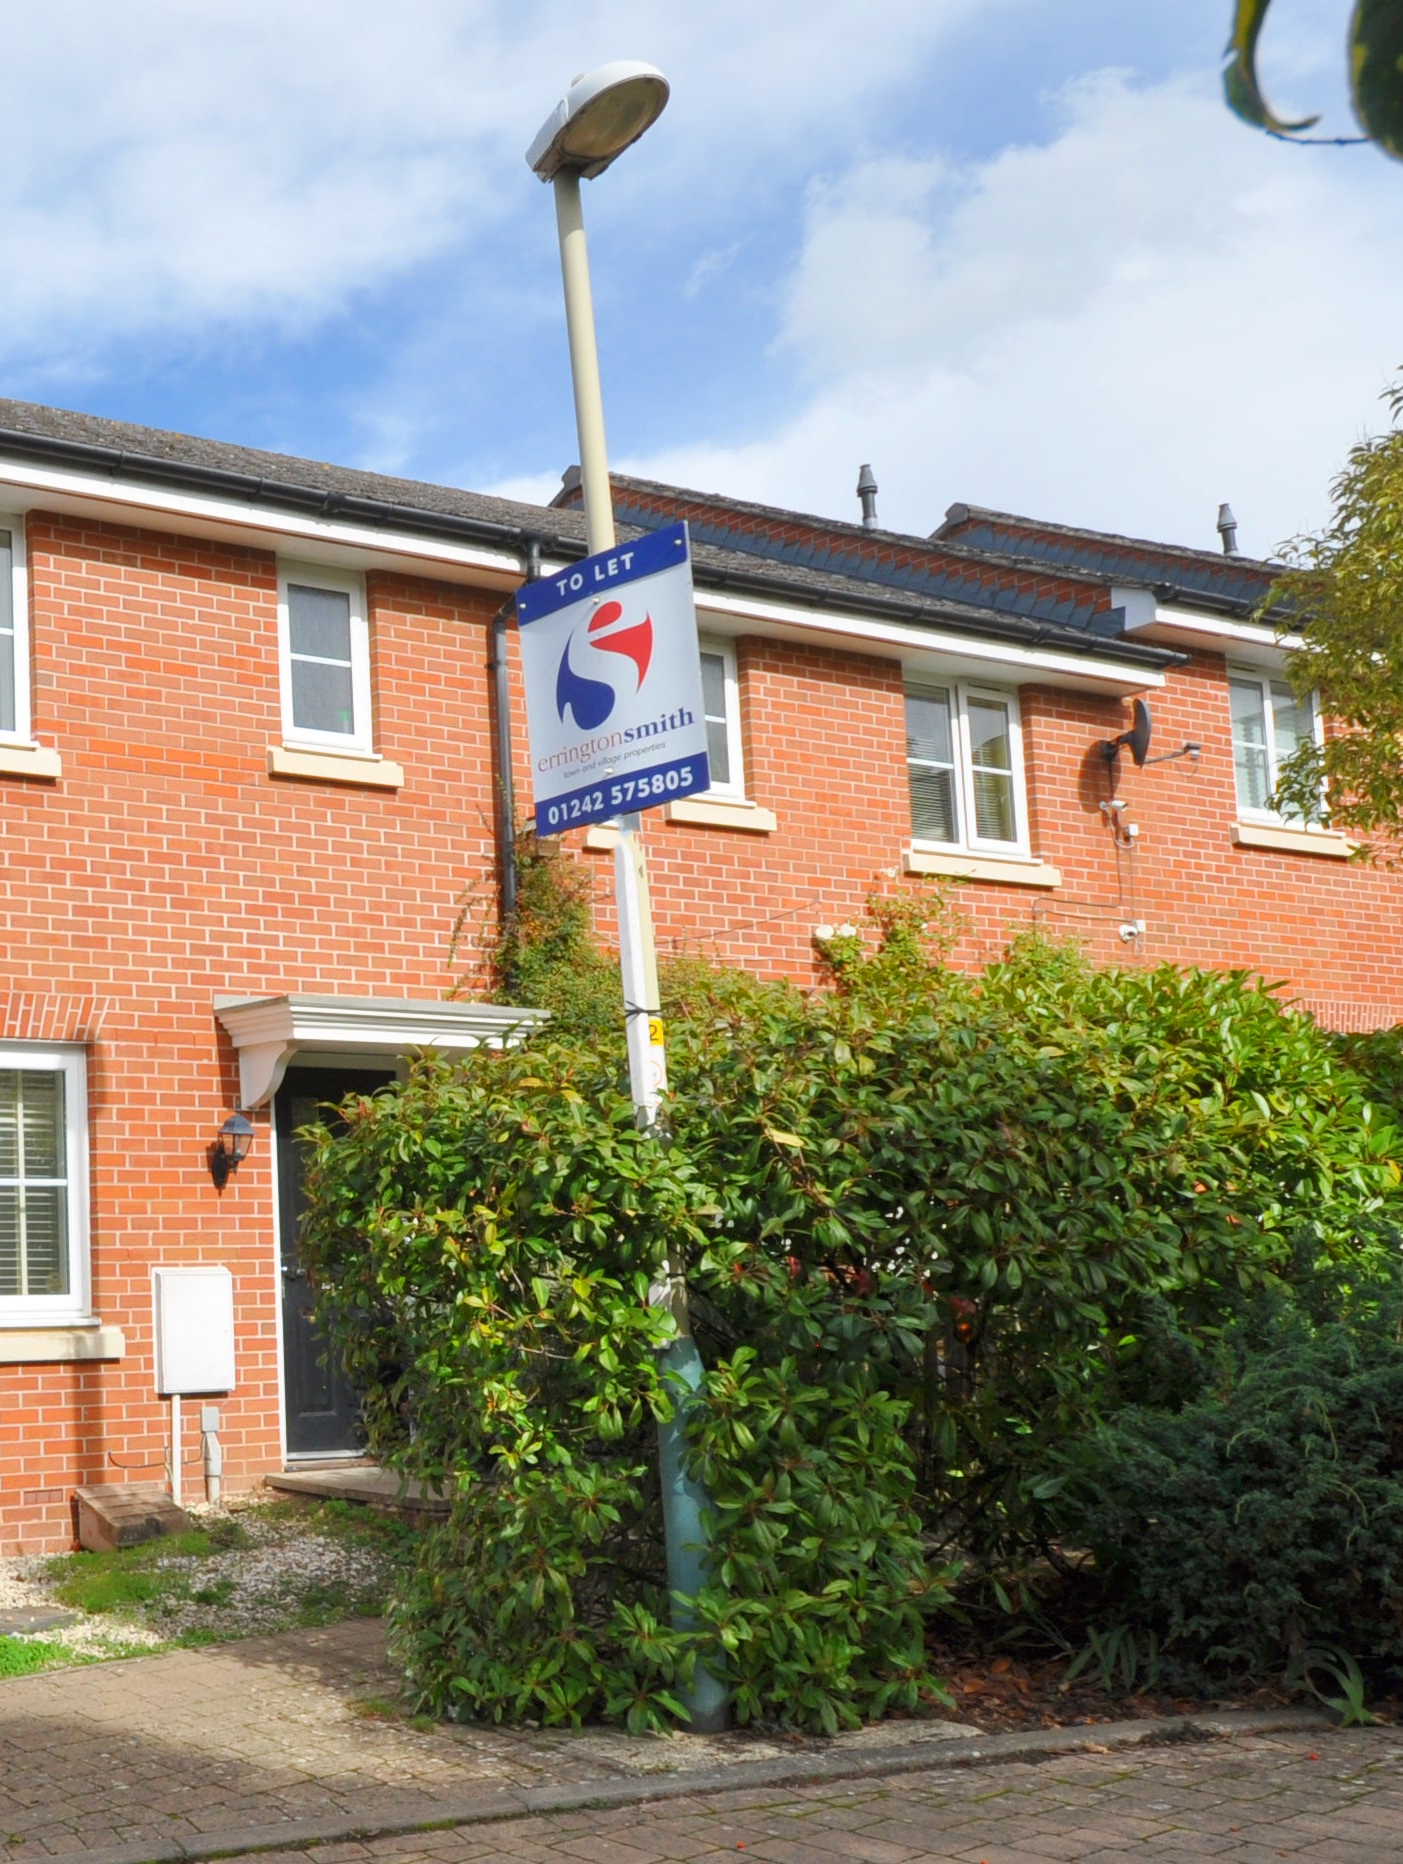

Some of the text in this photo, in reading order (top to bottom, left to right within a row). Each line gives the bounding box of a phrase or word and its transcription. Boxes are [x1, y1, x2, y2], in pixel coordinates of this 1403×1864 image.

[556, 552, 634, 596] TO LET
[537, 706, 695, 772] erringtonsmith
[582, 759, 596, 772] and
[597, 754, 622, 767] village
[623, 742, 667, 760] properties
[548, 766, 693, 825] 01242 575805
